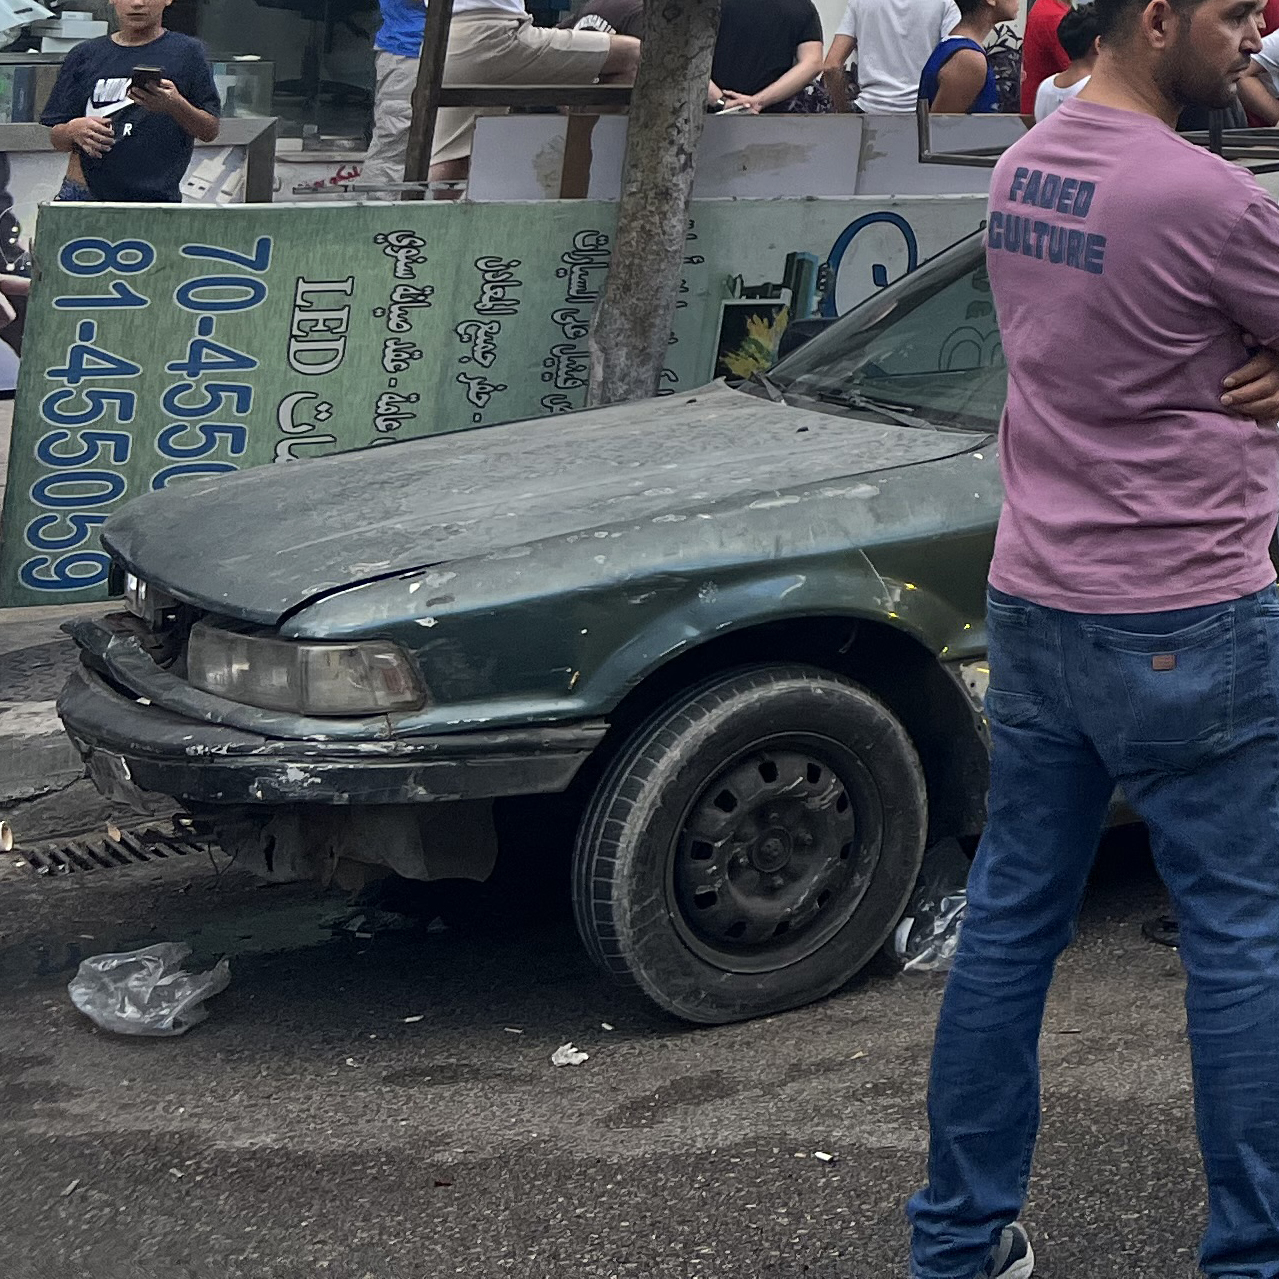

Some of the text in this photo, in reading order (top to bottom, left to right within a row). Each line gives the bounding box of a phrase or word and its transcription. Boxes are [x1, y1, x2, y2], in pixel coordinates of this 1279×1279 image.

[92, 77, 133, 103] NIK
[1009, 166, 1096, 218] FADED
[987, 211, 1107, 275] CULTURE
[474, 255, 523, 316] المعادن
[287, 275, 355, 377] LED
[455, 320, 502, 369] جميع
[18, 236, 157, 592] 81-455059
[456, 372, 508, 409] حفر
